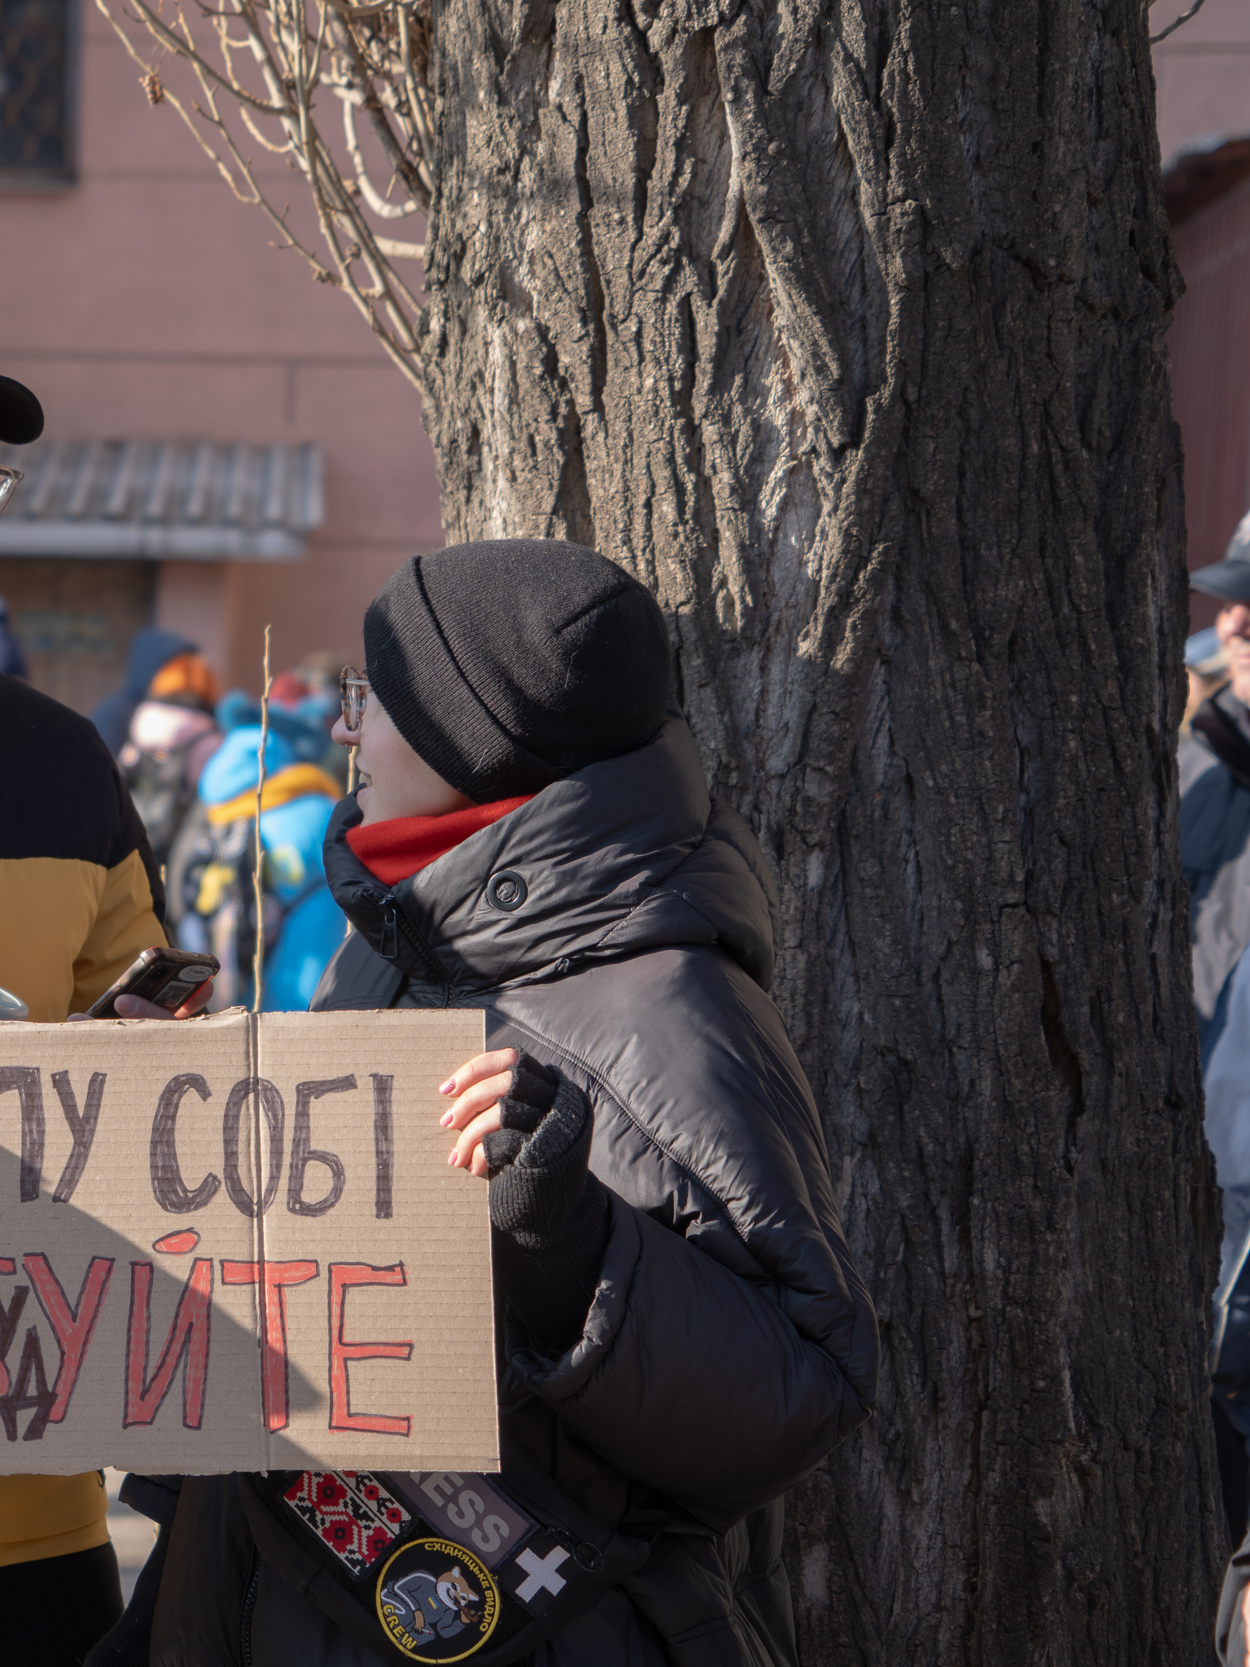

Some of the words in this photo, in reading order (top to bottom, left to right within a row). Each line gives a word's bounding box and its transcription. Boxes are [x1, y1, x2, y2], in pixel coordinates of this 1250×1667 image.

[149, 1072, 396, 1220] СОБІ
[410, 1472, 510, 1553] ESS
[383, 1604, 418, 1650] CREW
[424, 1542, 490, 1589] СХІДНЯЦЬКЕ
[479, 1590, 495, 1632] БИДЛО
